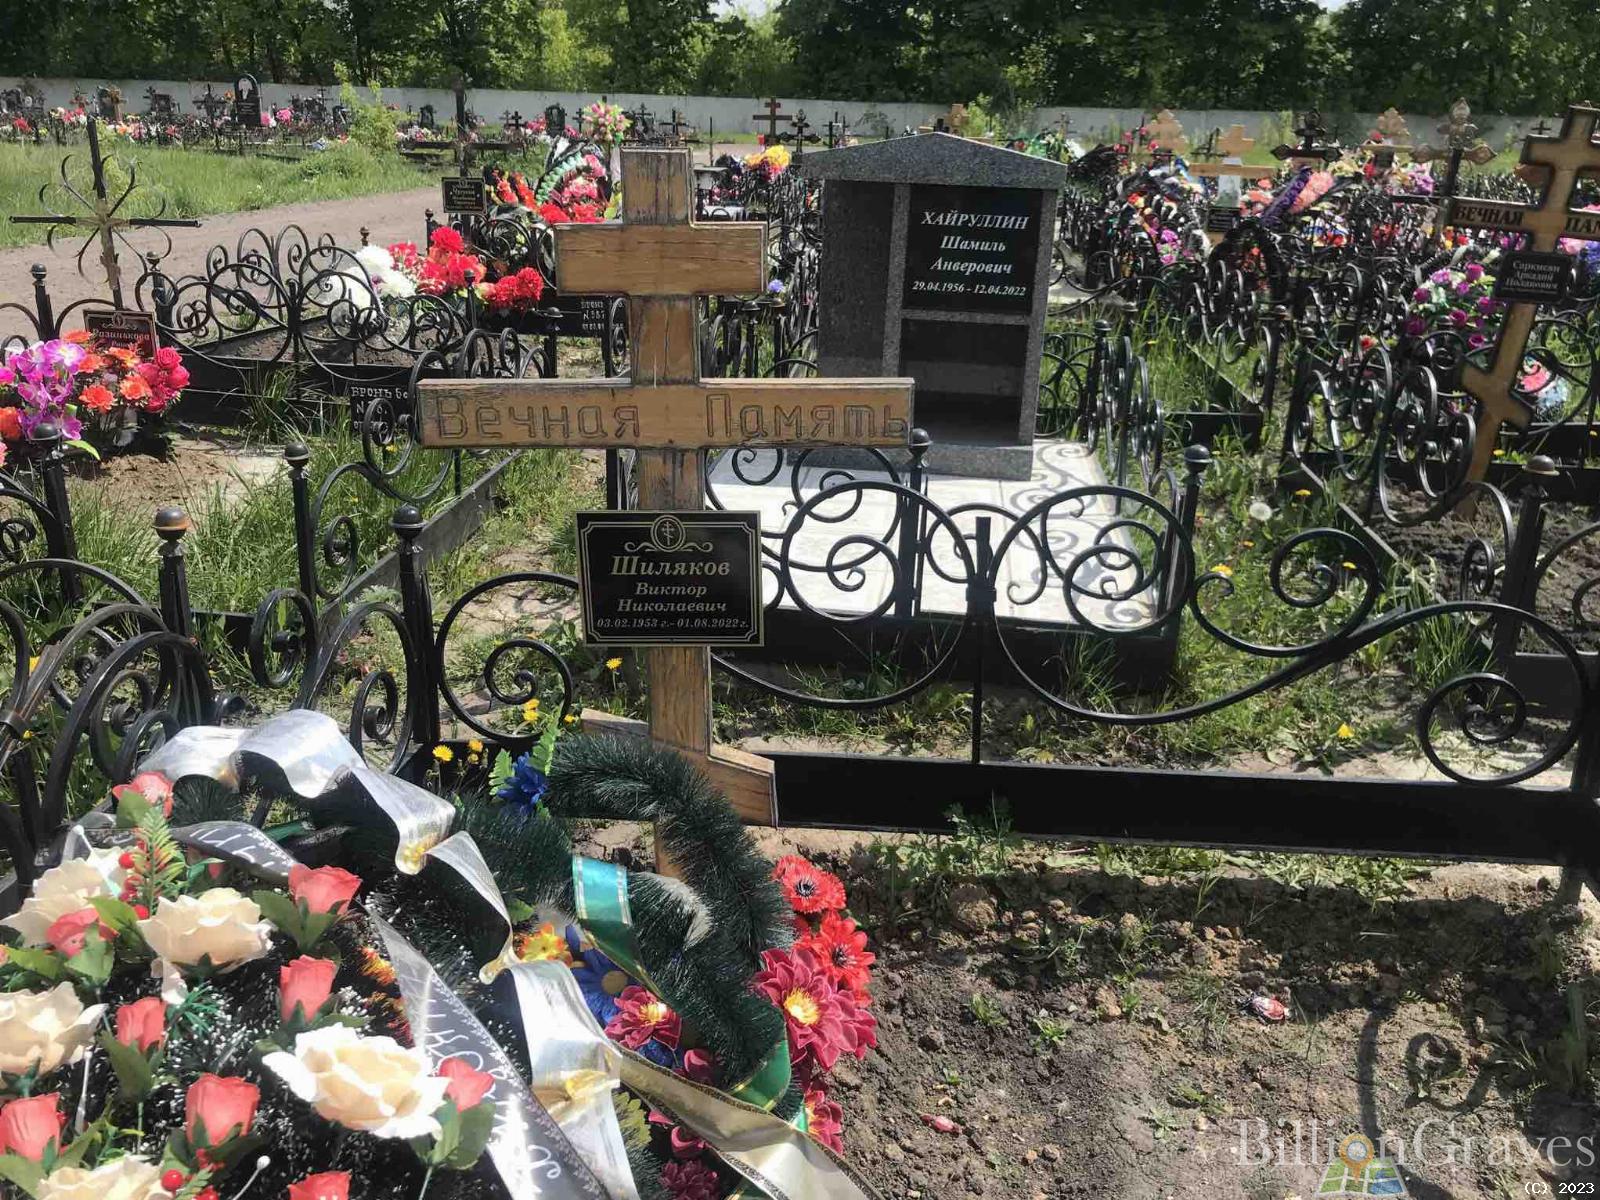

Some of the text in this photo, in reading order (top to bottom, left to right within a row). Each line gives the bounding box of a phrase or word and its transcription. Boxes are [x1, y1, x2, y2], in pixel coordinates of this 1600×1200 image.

[921, 209, 1029, 230] ХАЙРУЛЛИН
[940, 235, 1006, 252] Шамиль
[930, 257, 1012, 275] Анверович
[912, 280, 965, 293] 29.04.1956
[974, 284, 1026, 296] 12.04.2022
[706, 393, 908, 438] Память
[610, 555, 731, 576] Шиляков
[635, 582, 708, 598] Виктор
[617, 598, 727, 612] Николаевич
[597, 618, 659, 629] 03.02.1953
